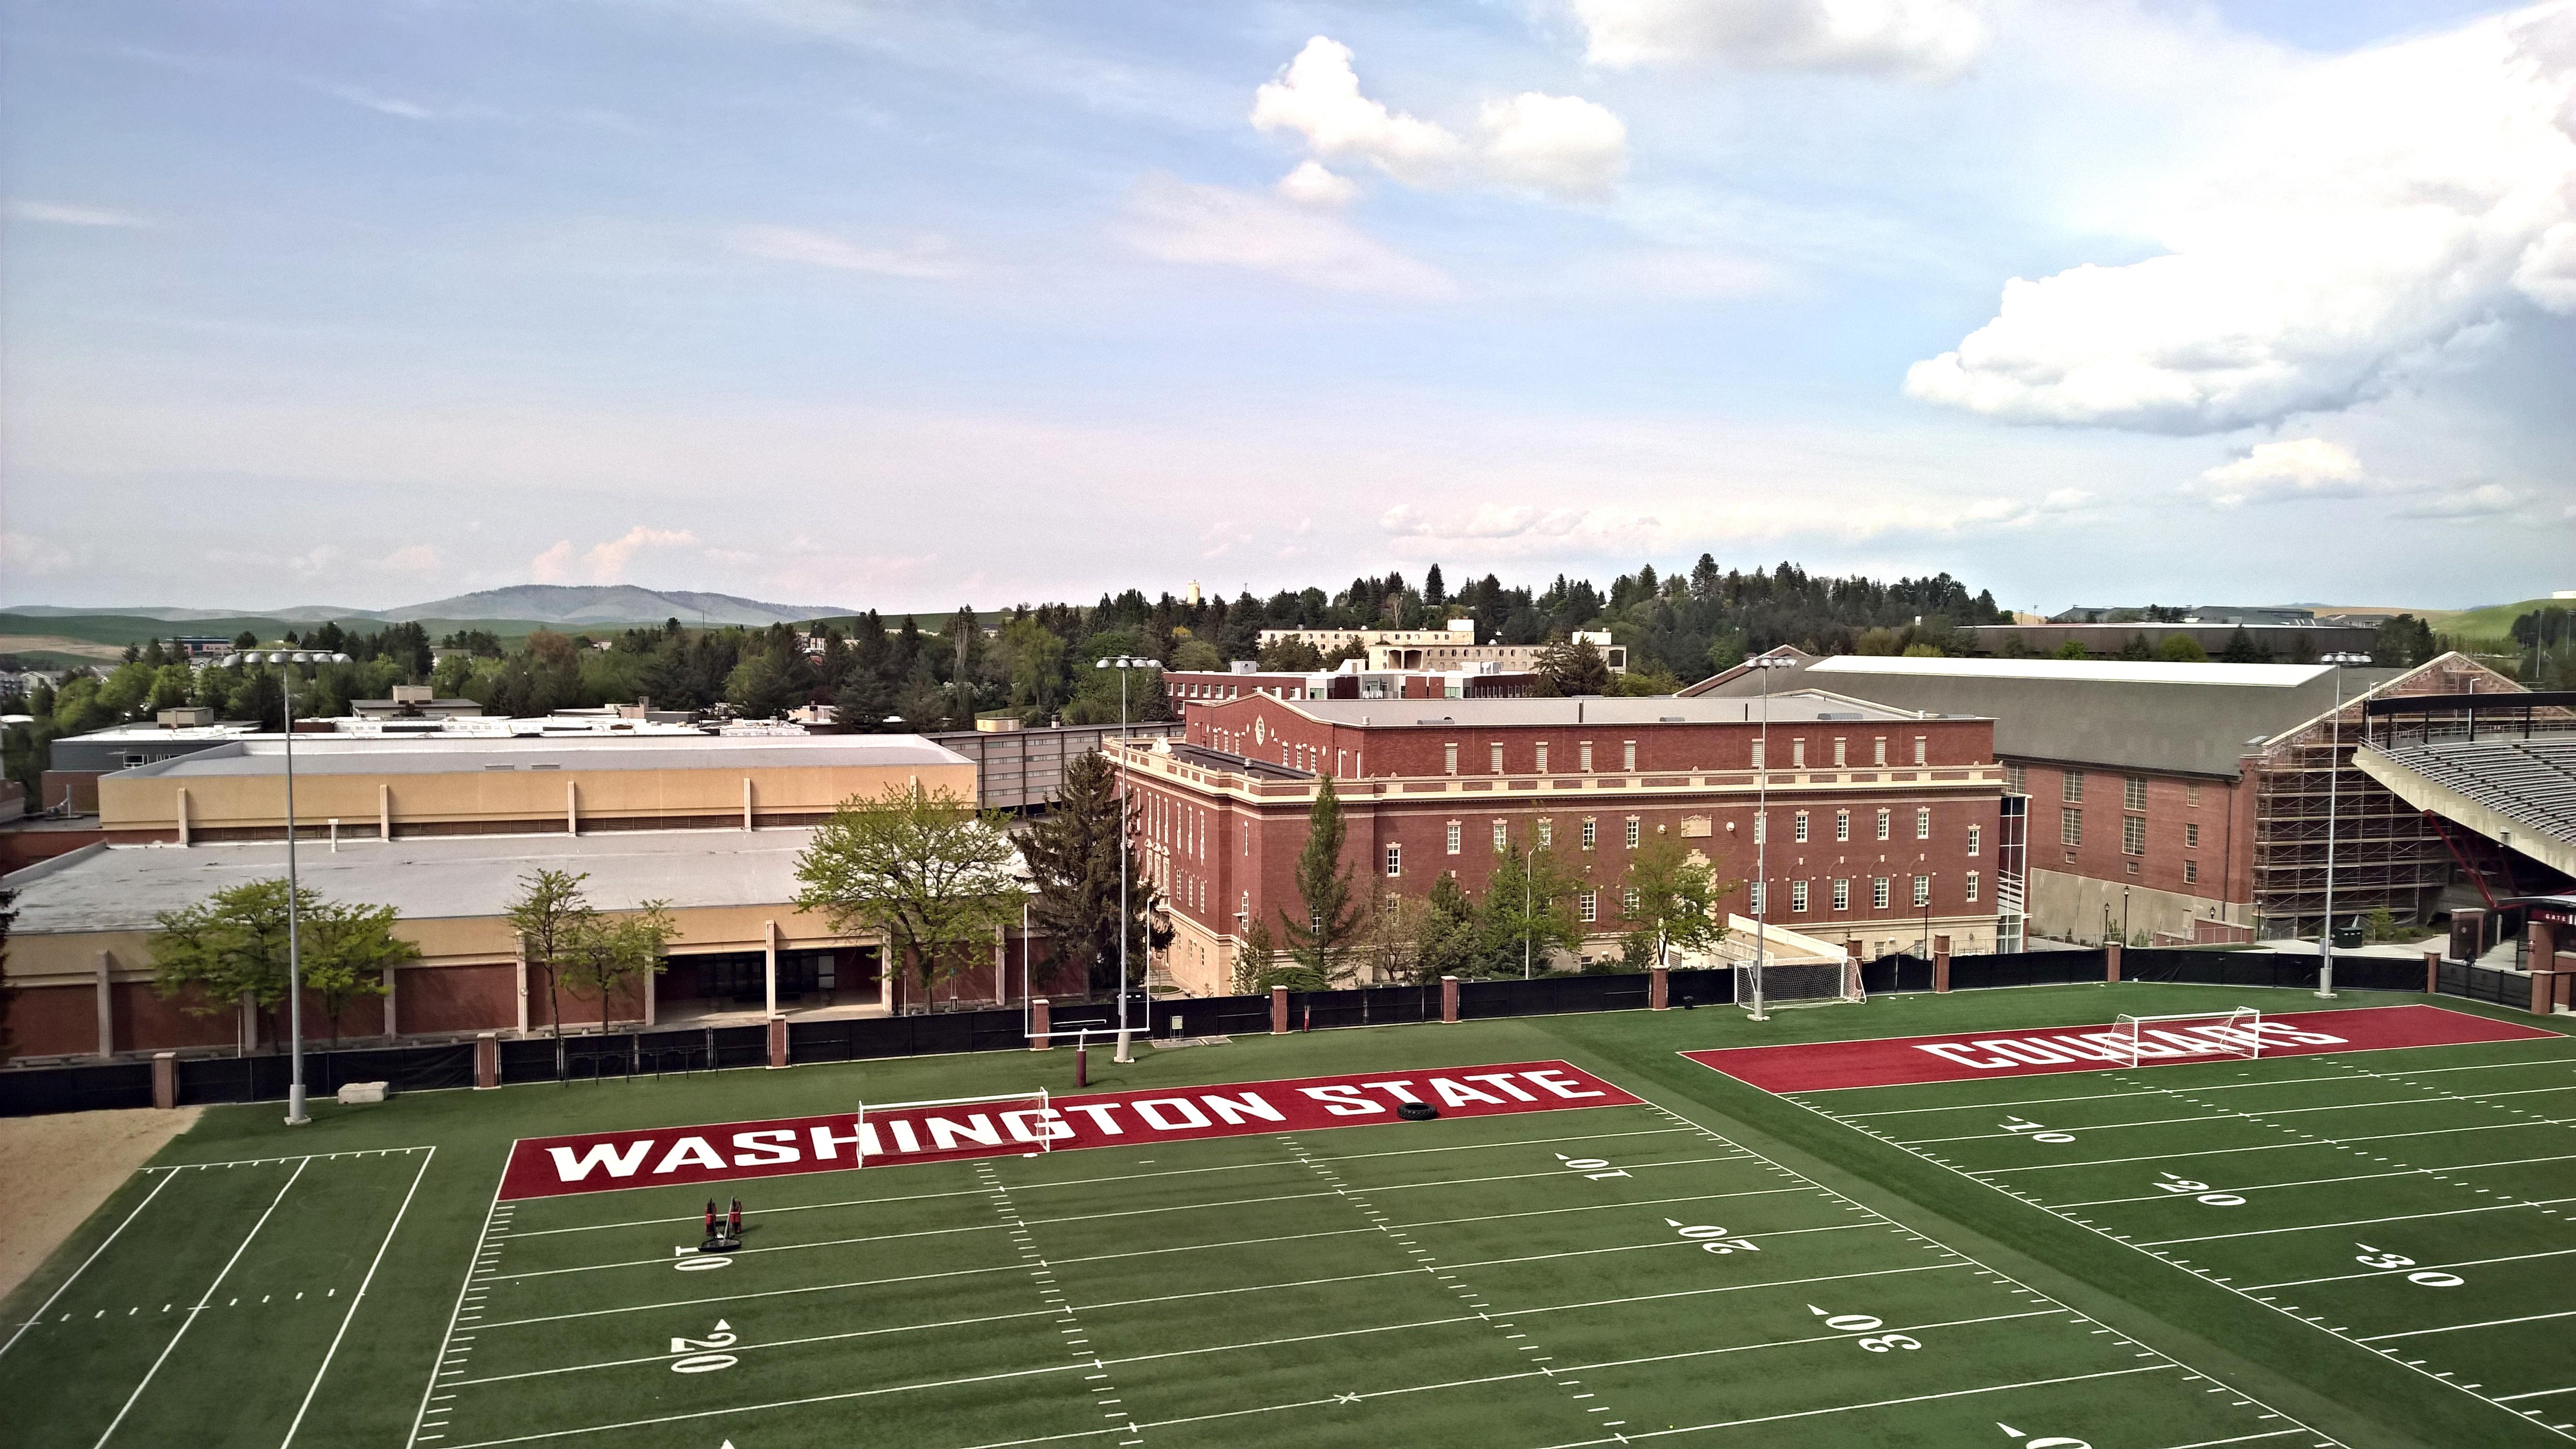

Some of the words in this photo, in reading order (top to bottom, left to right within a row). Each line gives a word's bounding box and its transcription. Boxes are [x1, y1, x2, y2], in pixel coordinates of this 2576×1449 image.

[2545, 913, 2566, 922] GATE
[1911, 1022, 2349, 1068] COUGARS
[545, 1092, 1287, 1182] WASHINGTON
[1296, 1070, 1606, 1116] STATE
[1998, 1121, 2076, 1143] 10
[1565, 1159, 1633, 1181] 10
[2153, 1180, 2246, 1206] 20
[1679, 1225, 1761, 1254] 20
[2356, 1254, 2464, 1287] 30
[1826, 1314, 1922, 1353] 30
[671, 1333, 738, 1373] 20
